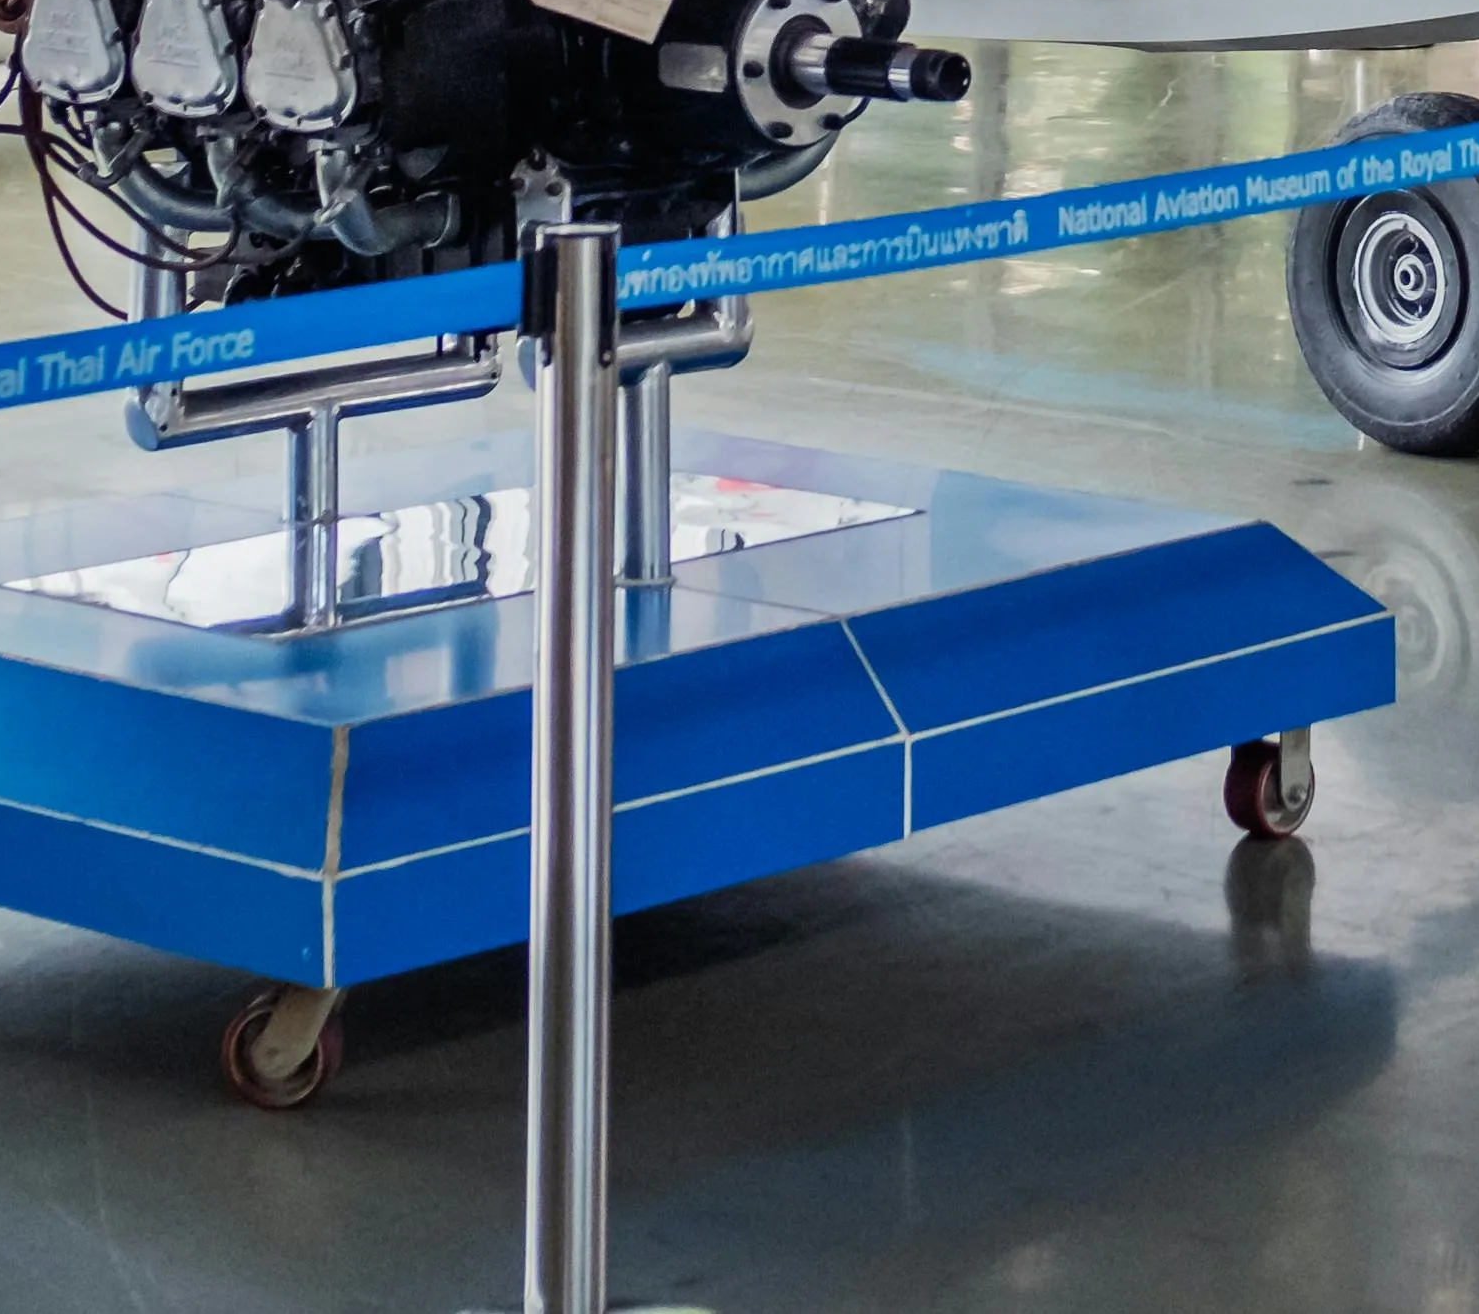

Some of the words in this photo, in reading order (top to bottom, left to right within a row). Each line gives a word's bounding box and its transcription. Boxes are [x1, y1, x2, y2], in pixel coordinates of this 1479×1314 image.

[1057, 191, 1148, 237] National
[1153, 181, 1240, 225] Aviation
[1245, 170, 1332, 211] Museum
[1336, 159, 1359, 189] of
[1361, 155, 1396, 185] the
[1399, 143, 1453, 183] Royal
[36, 344, 106, 392] Thai
[116, 339, 162, 379] Air
[171, 323, 256, 372] Force
